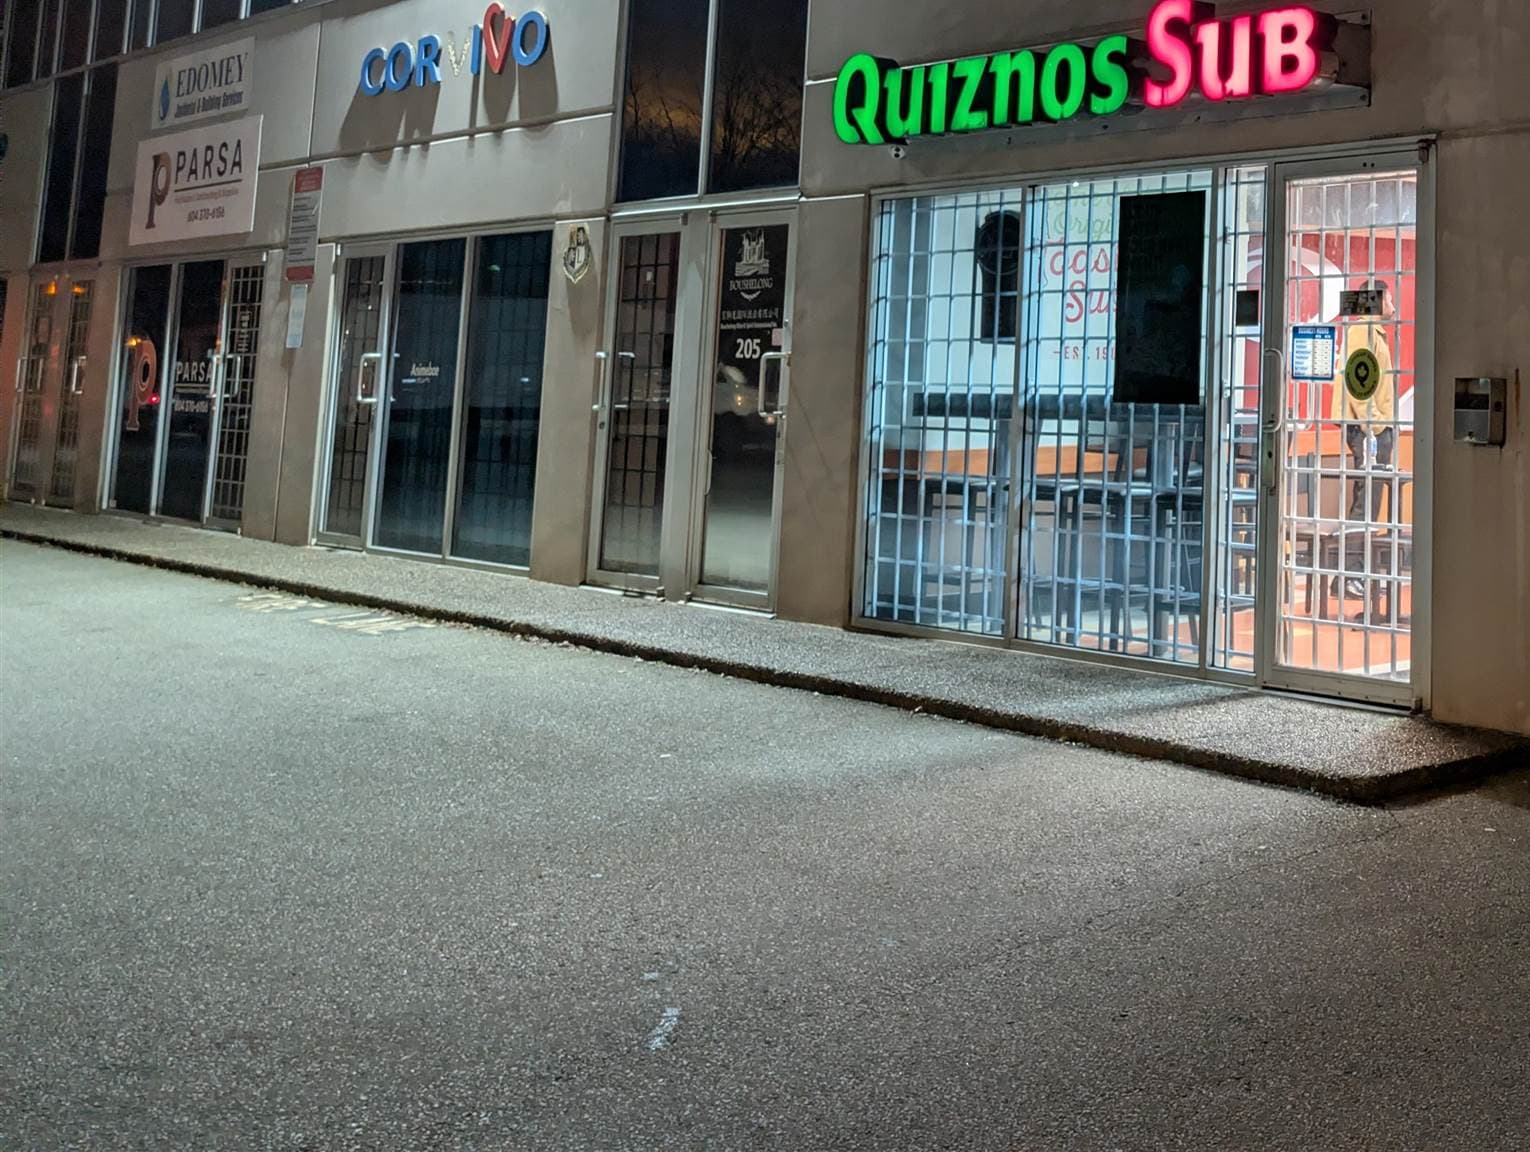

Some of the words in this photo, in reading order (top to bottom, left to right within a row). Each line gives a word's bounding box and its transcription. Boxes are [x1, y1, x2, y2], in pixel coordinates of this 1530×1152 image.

[176, 52, 248, 98] EDOMEY
[833, 35, 1129, 144] Quiznos
[174, 138, 242, 185] PARSA
[735, 338, 760, 359] 205
[175, 361, 214, 383] PARSA
